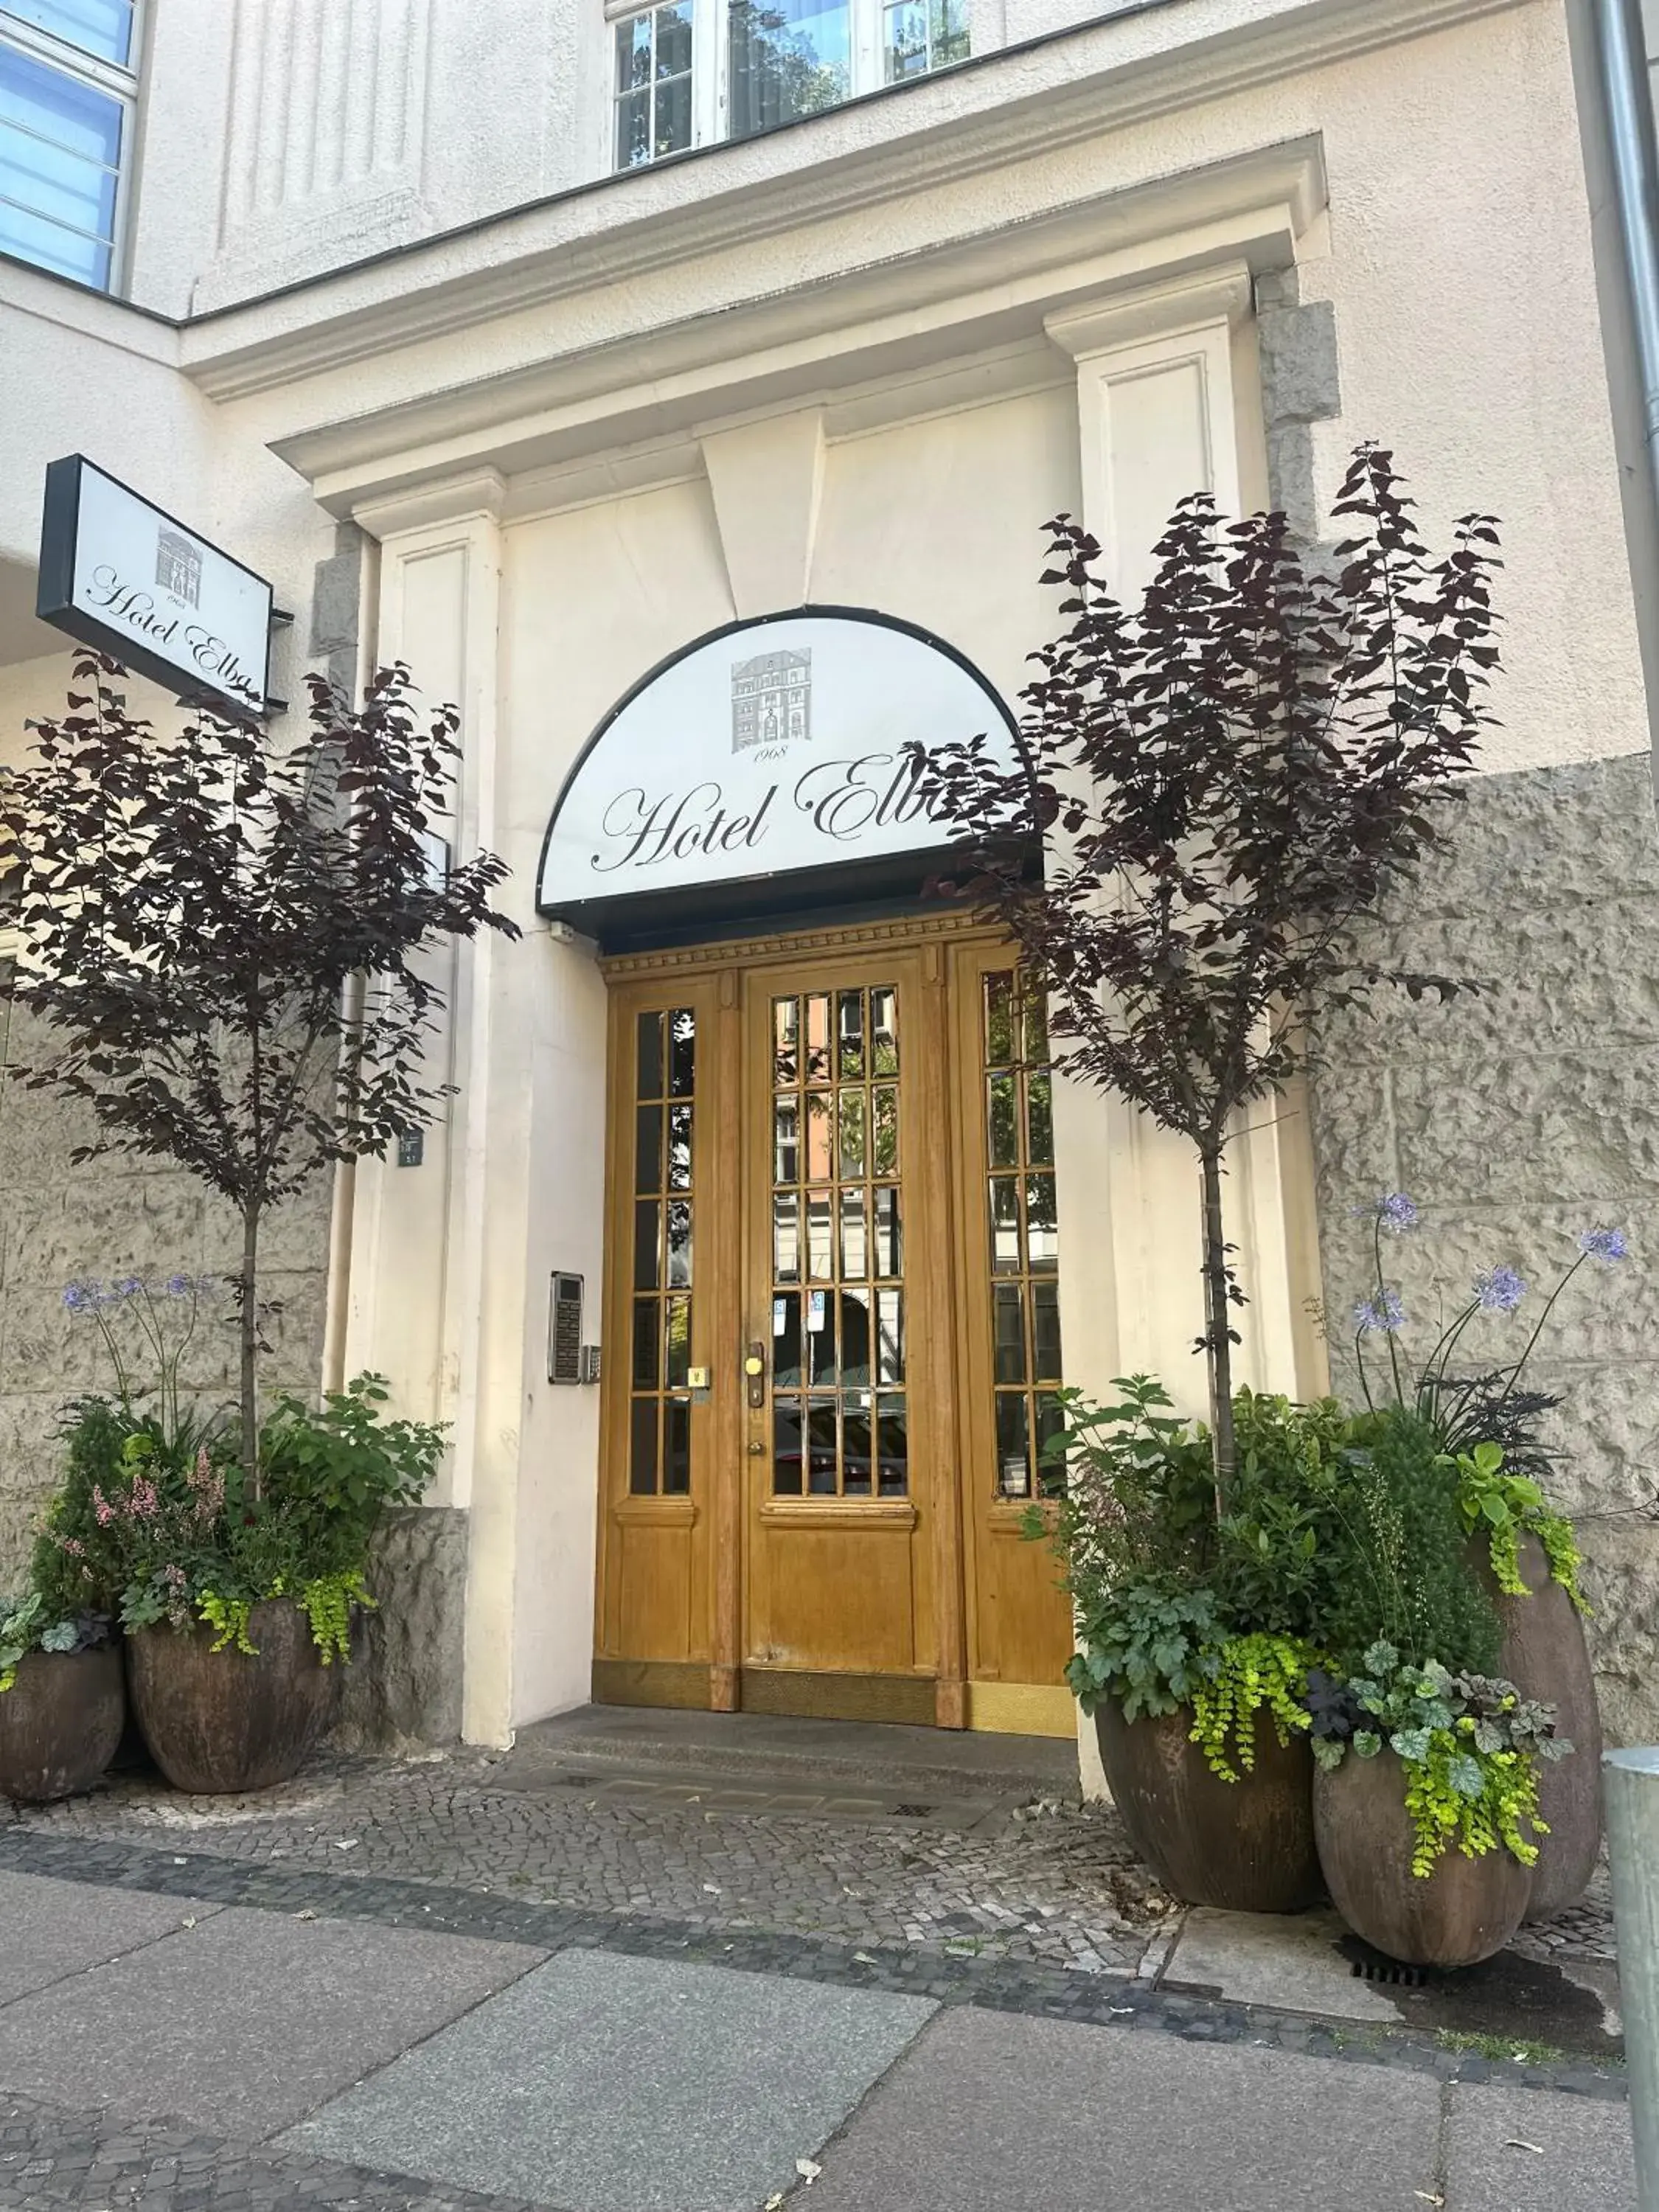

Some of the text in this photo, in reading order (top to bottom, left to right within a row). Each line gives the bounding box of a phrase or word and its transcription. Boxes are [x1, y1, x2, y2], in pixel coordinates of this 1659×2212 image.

[85, 563, 254, 689] Hotel Elba
[591, 782, 779, 872] Hotel
